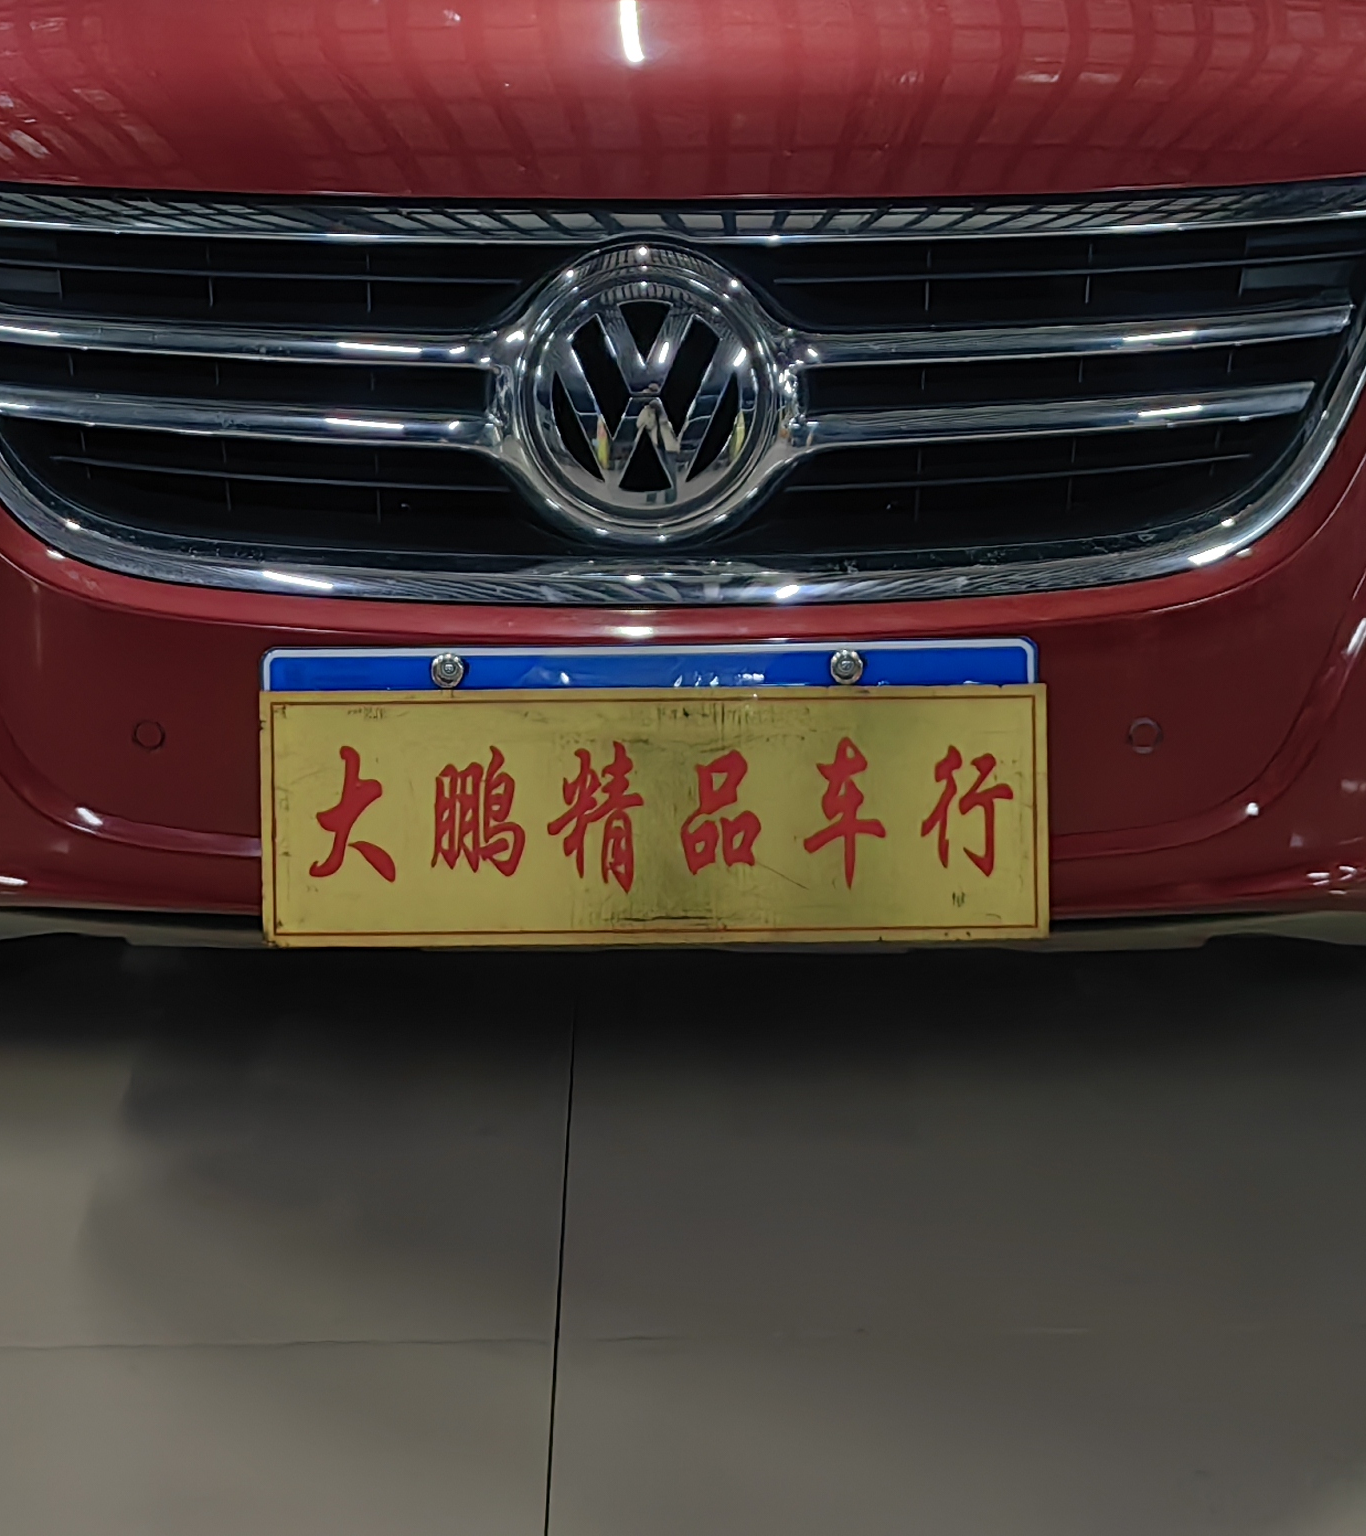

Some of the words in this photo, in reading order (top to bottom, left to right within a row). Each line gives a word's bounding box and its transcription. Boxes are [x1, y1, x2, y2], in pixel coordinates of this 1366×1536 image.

[307, 734, 1016, 896] 大鹏精品车行
